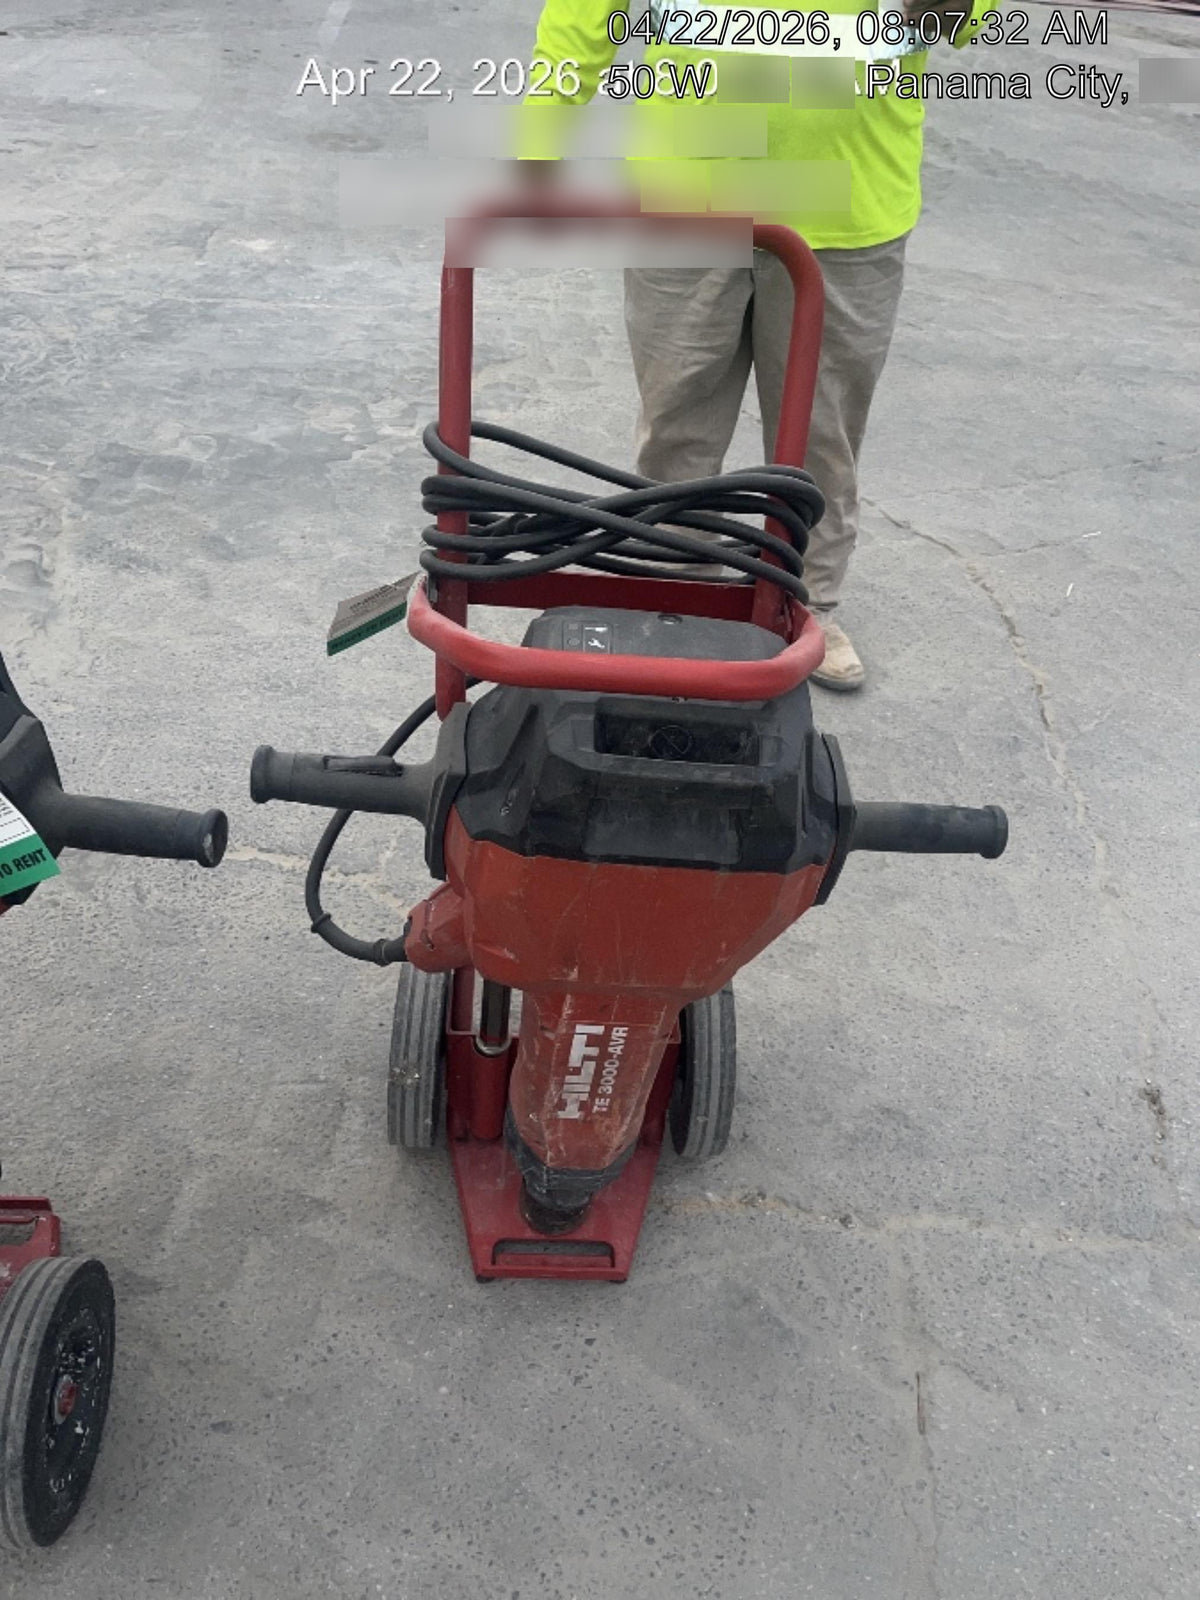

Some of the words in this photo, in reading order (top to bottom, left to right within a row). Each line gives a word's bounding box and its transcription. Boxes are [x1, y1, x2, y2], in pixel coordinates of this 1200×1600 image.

[12, 848, 47, 872] RENT
[557, 1023, 605, 1119] HILTI
[598, 1026, 630, 1094] 3000-AVR
[592, 1098, 610, 1113] TE
